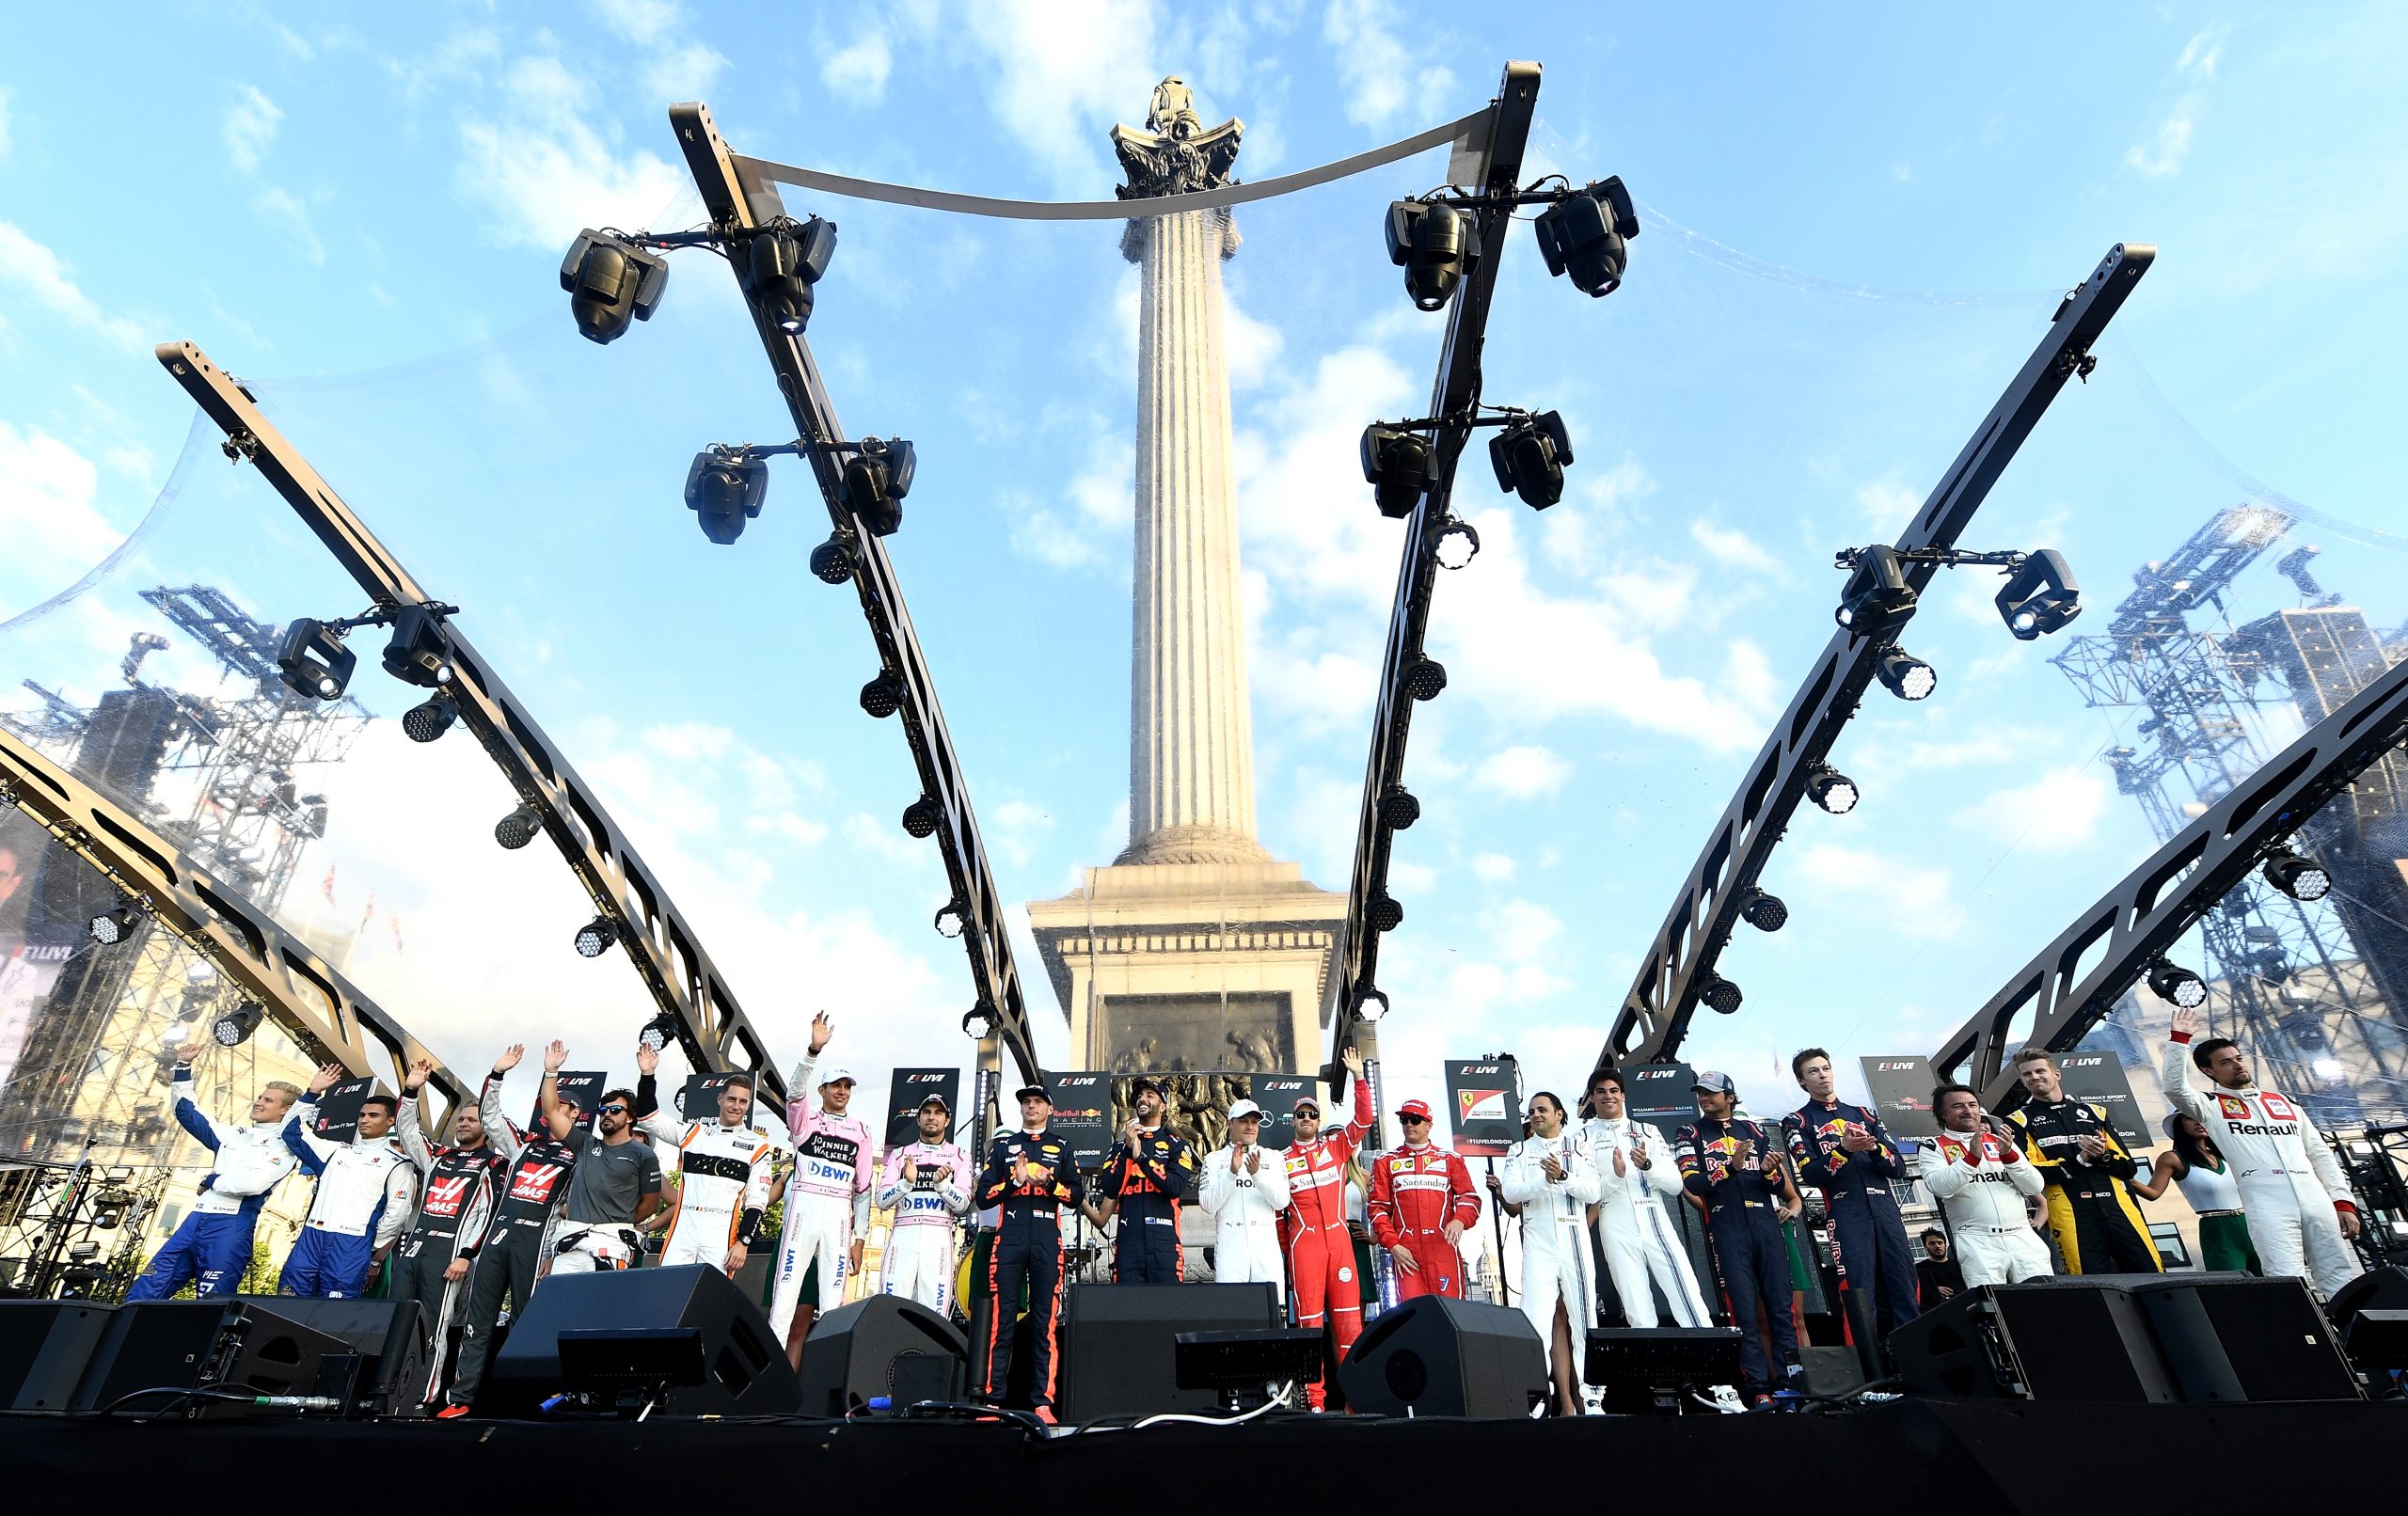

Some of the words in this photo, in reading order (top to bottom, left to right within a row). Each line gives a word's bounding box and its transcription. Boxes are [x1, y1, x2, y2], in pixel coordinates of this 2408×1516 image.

[2077, 1058, 2102, 1066] LIVE
[921, 1074, 945, 1082] LIVE
[2227, 1122, 2299, 1136] Renault
[2045, 1137, 2067, 1145] Castrol
[814, 1145, 848, 1162] WALKER
[821, 1166, 850, 1182] BWT
[1299, 1173, 1338, 1187] Santander
[1402, 1178, 1447, 1188] Santander
[512, 1185, 549, 1199] HAAS
[426, 1202, 459, 1213] HAAS
[913, 1197, 945, 1211] BWT
[1045, 1210, 1055, 1219] MAX
[491, 1228, 508, 1245] 8
[784, 1249, 795, 1272] BWT
[836, 1254, 846, 1278] BWT
[937, 1283, 945, 1305] BWT
